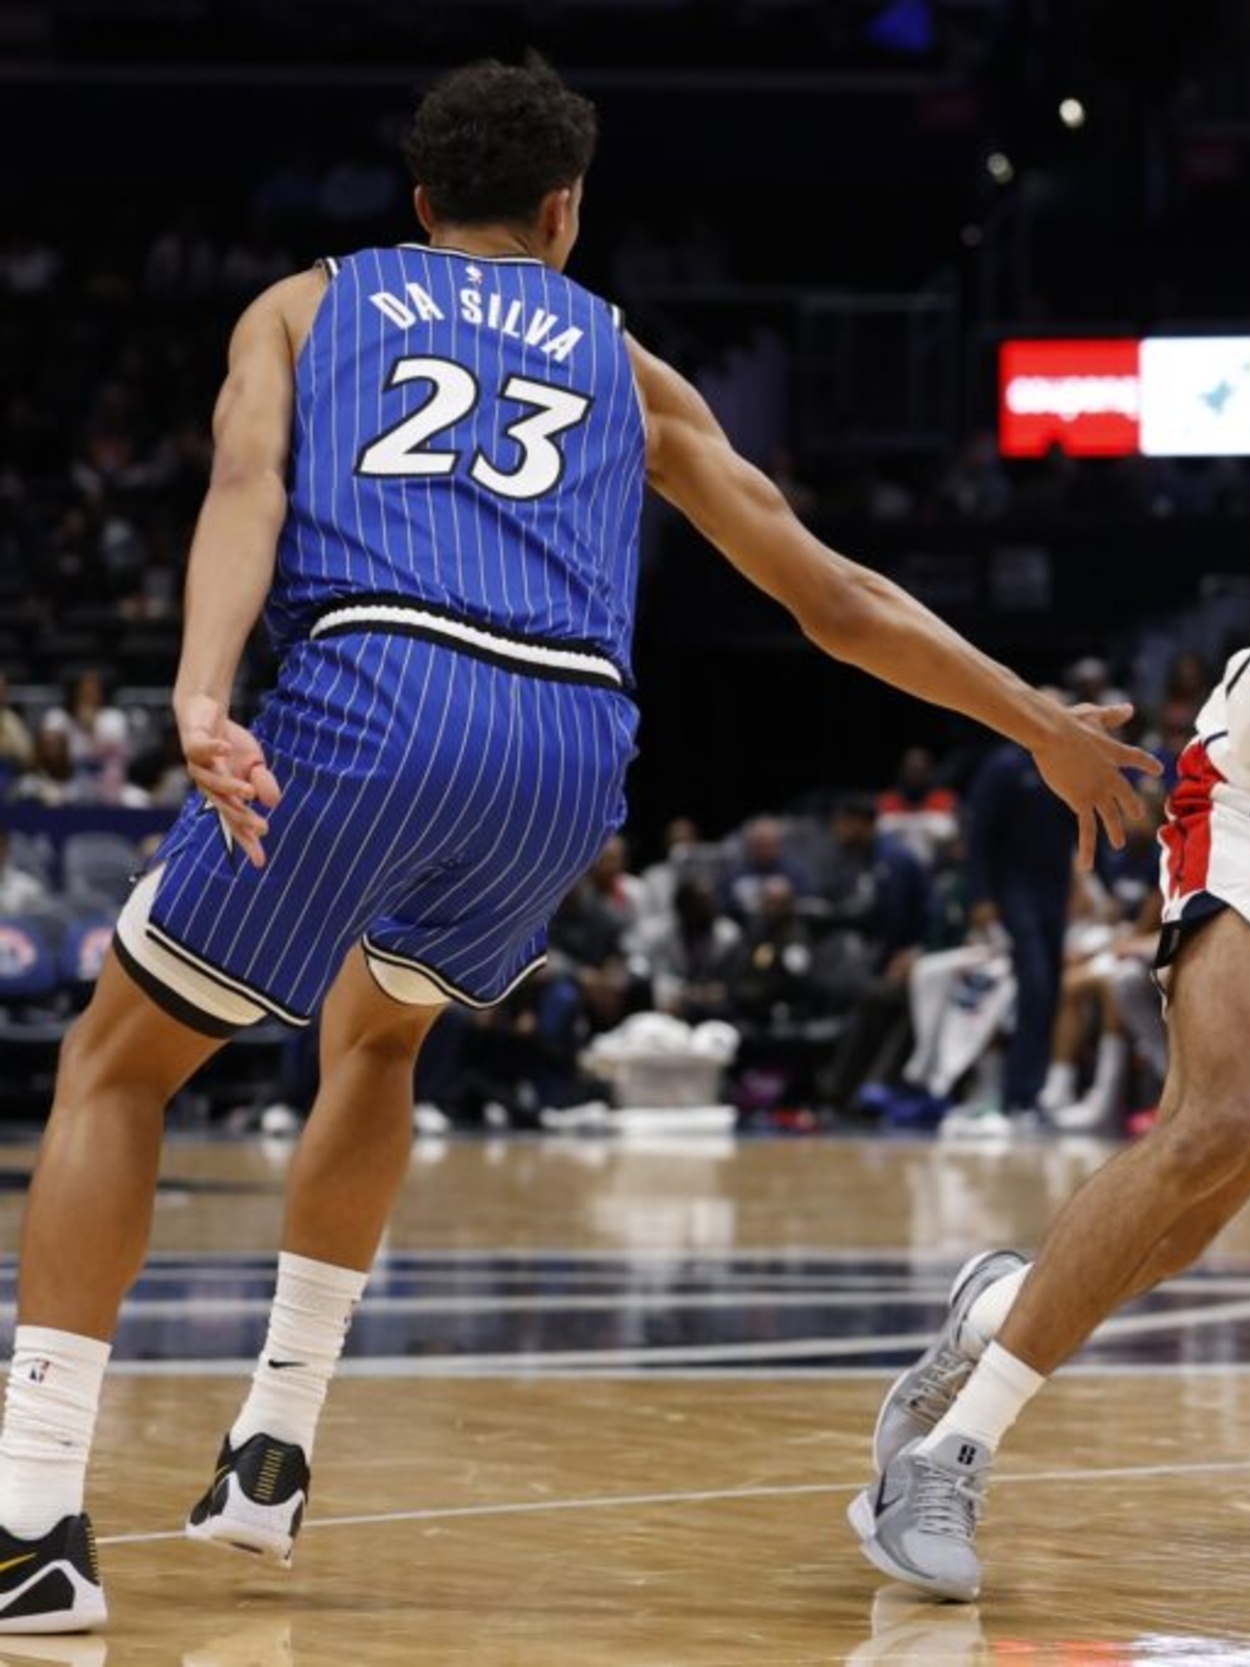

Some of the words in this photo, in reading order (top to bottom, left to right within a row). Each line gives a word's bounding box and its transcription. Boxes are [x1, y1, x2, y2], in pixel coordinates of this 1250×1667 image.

[369, 282, 446, 331] DA
[460, 288, 585, 363] SILVA
[354, 354, 594, 501] 23
